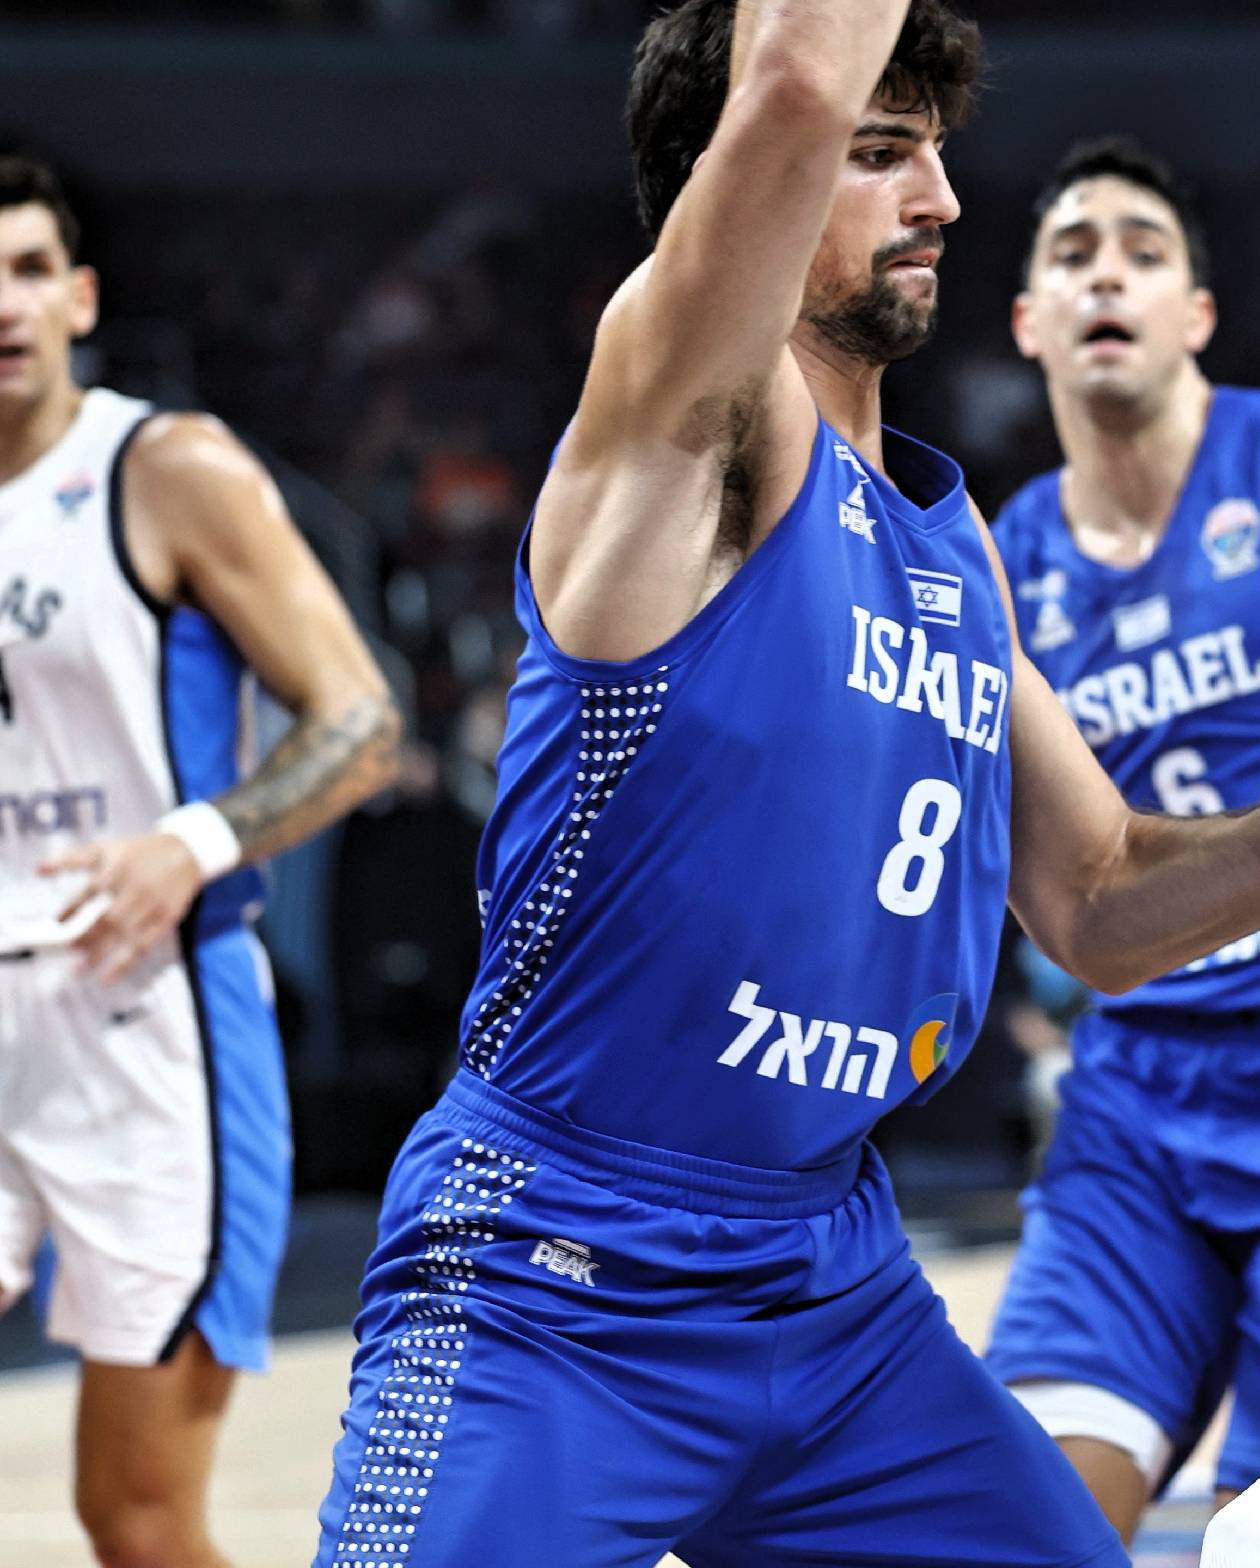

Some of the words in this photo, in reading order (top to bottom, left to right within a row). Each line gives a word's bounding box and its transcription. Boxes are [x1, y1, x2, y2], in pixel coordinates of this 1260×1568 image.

[876, 778, 962, 917] 8
[716, 980, 899, 1100] הראל
[530, 1239, 601, 1288] PEAK
